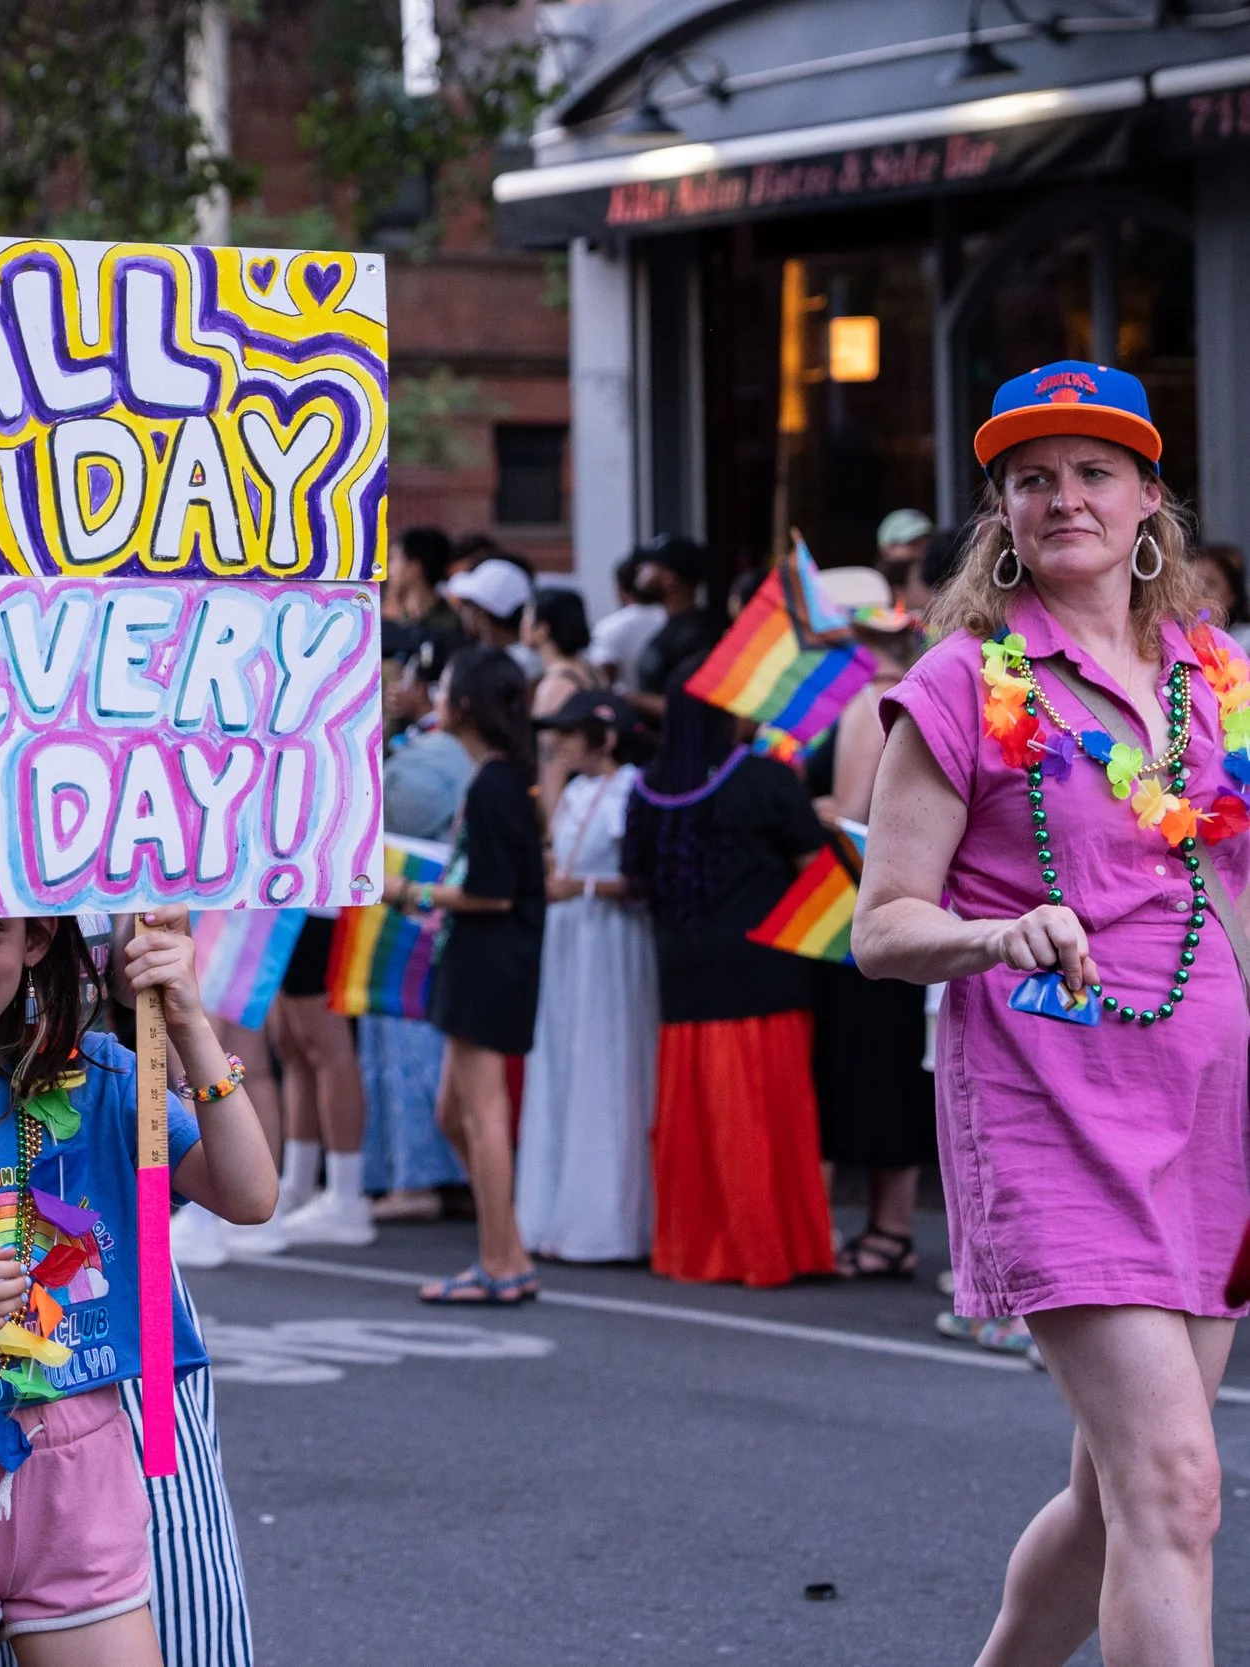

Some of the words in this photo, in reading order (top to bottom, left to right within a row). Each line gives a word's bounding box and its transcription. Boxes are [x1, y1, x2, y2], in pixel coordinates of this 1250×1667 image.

[50, 412, 334, 566] DAY
[30, 744, 307, 902] DAY!
[54, 1306, 108, 1345] CLUB
